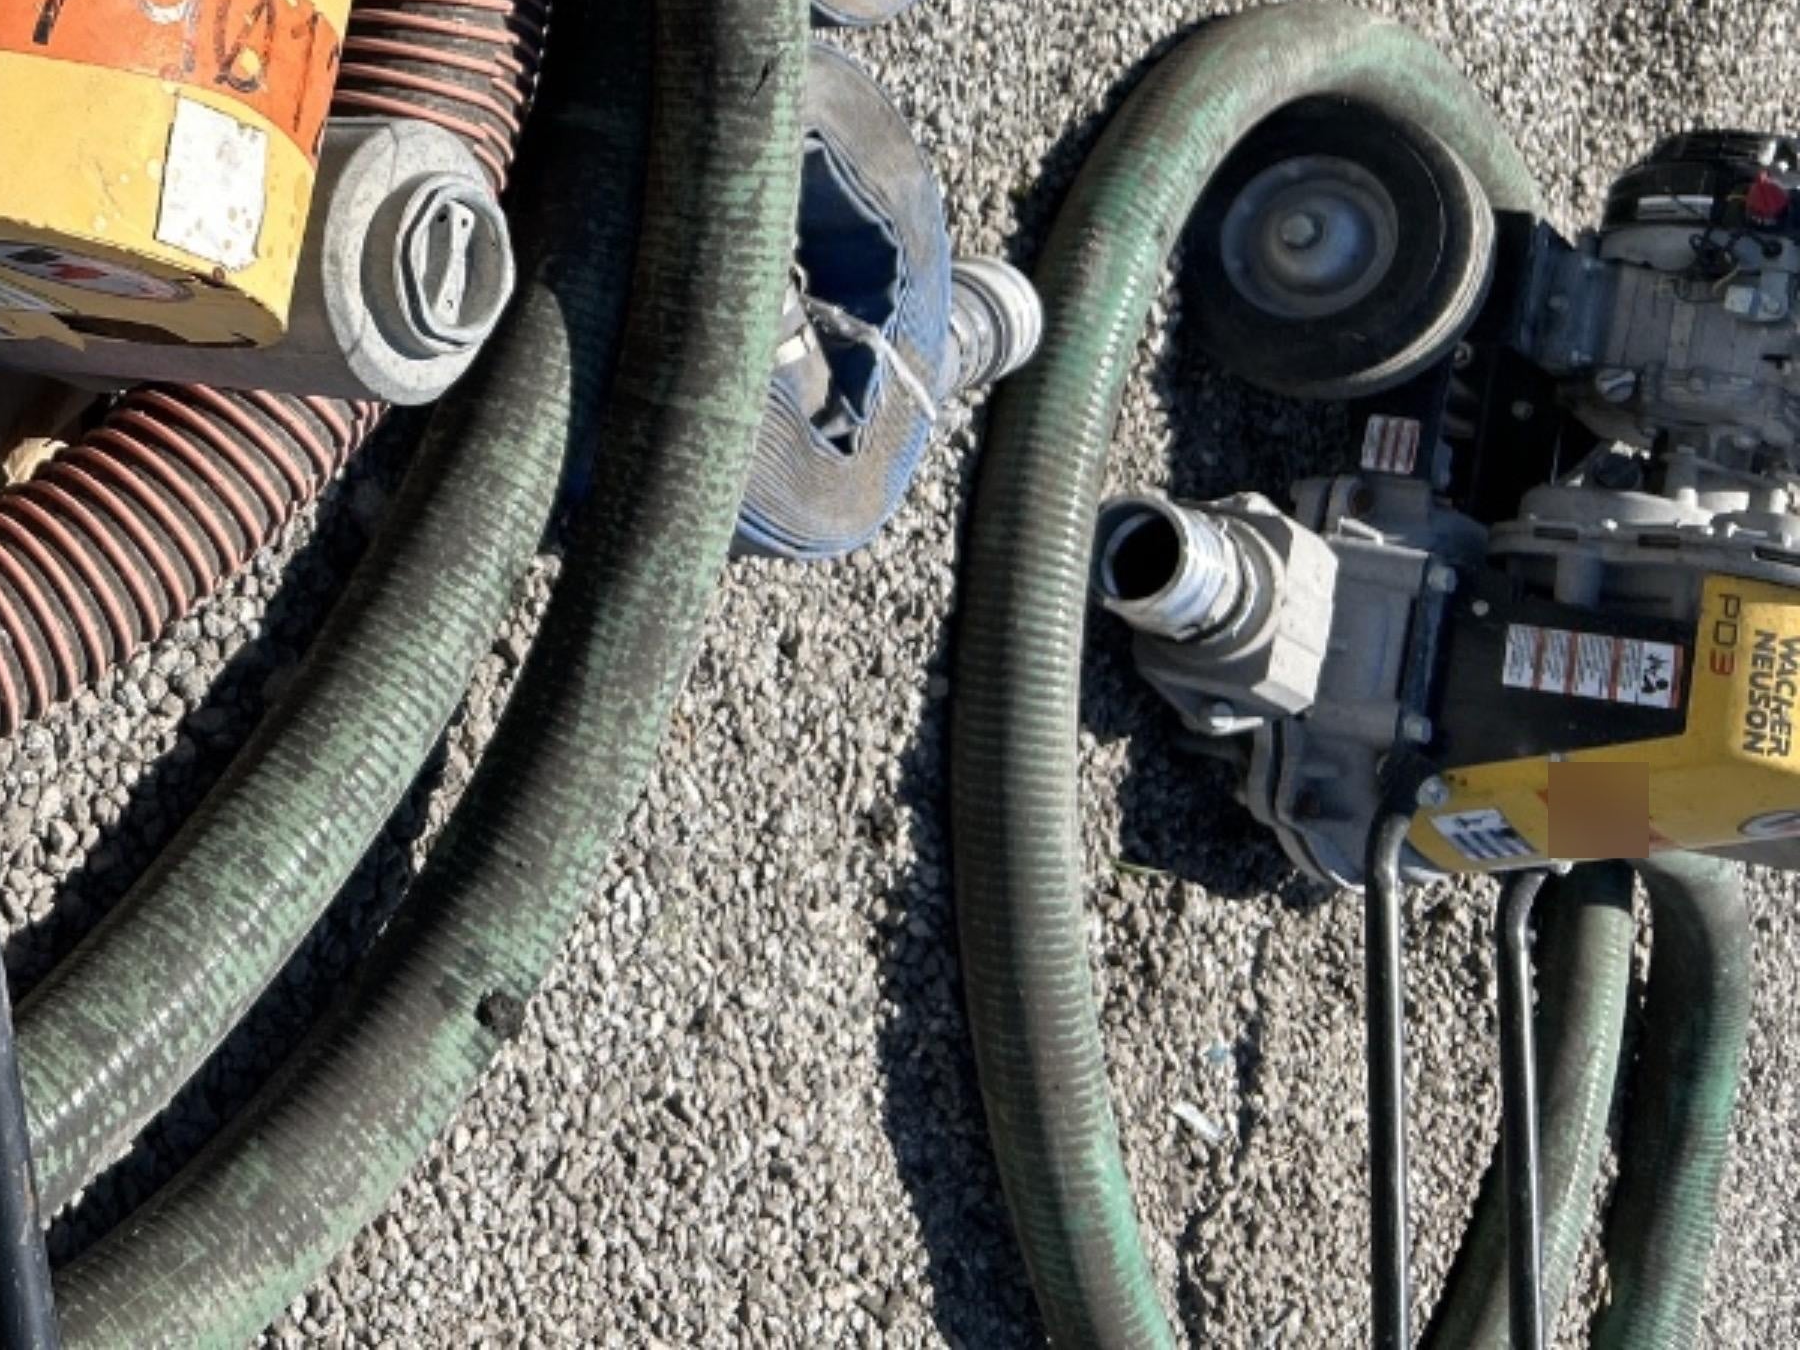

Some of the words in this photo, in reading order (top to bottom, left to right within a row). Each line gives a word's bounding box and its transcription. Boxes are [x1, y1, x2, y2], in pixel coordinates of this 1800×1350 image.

[1709, 592, 1741, 676] PD3
[1742, 628, 1777, 757] NEUSON
[1766, 636, 1800, 758] WACKER
